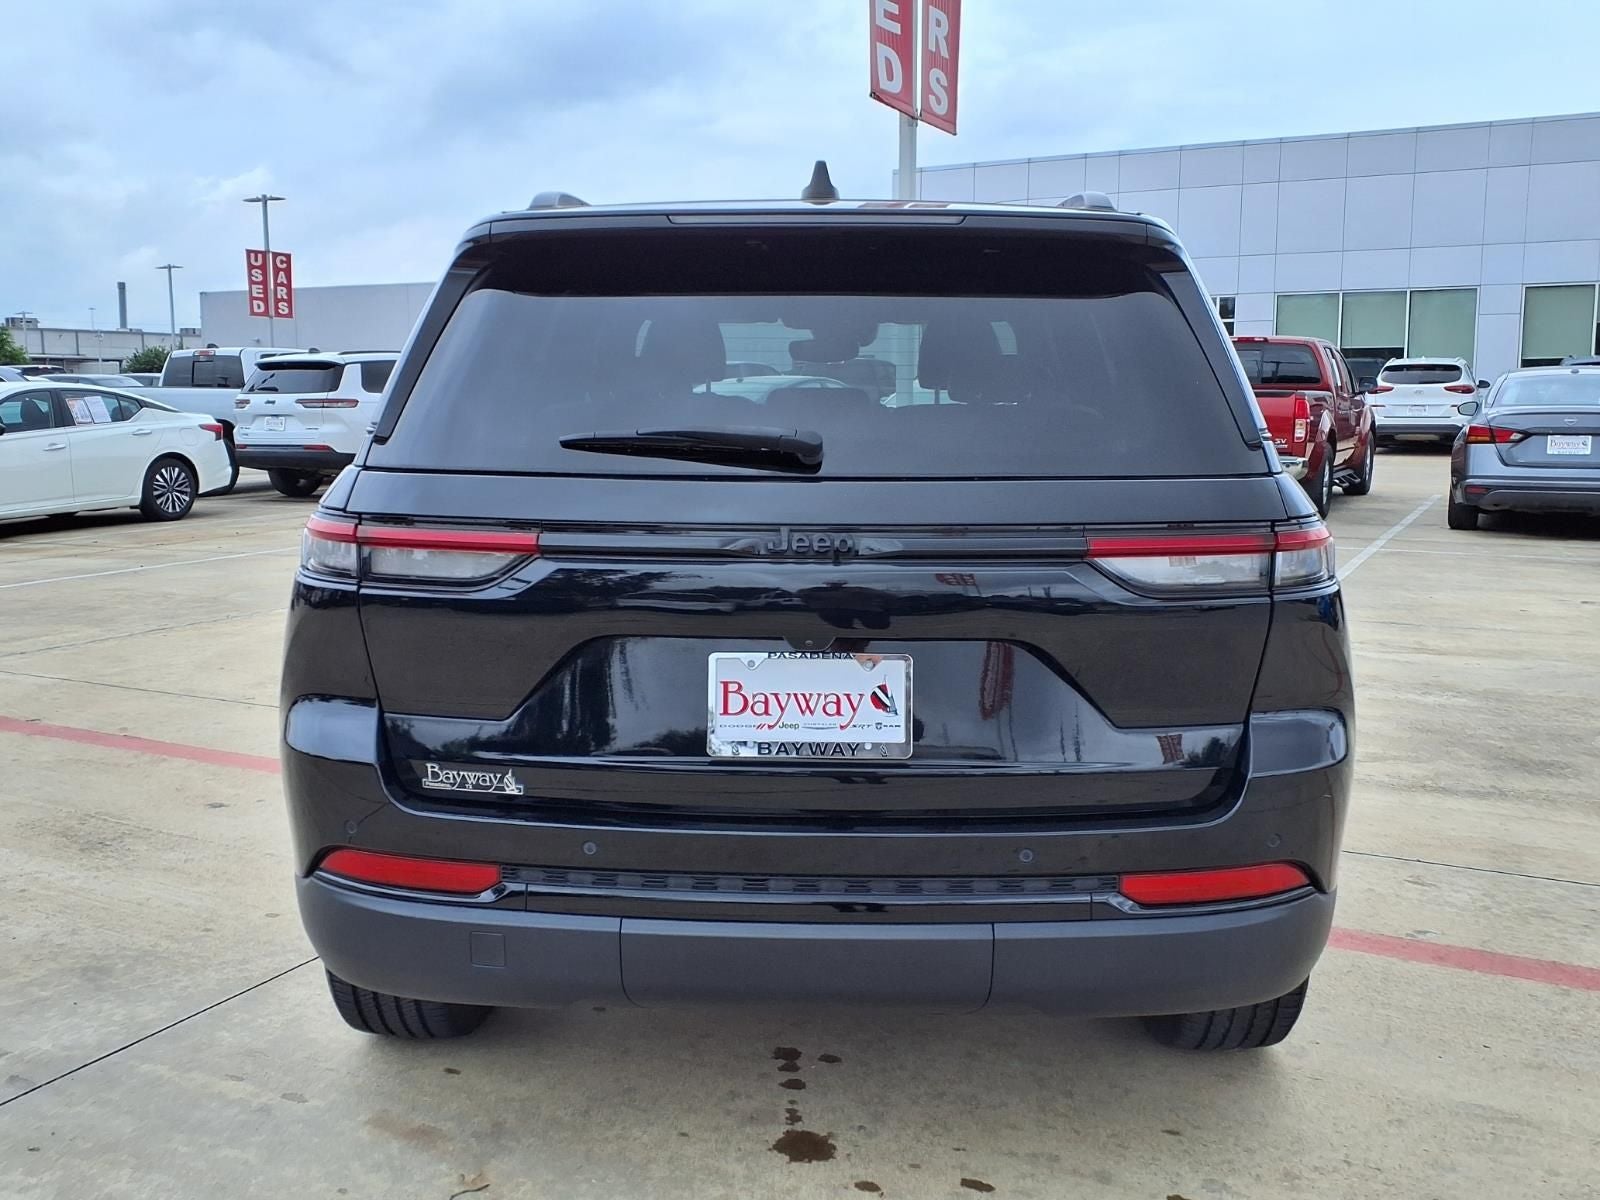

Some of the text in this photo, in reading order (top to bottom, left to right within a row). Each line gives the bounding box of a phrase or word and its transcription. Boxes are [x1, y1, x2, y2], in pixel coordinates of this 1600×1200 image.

[928, 5, 949, 115] RS
[250, 253, 265, 312] USED
[275, 255, 289, 315] CARS
[767, 527, 856, 566] Jeep
[767, 652, 855, 660] PASADENA
[719, 680, 865, 730] Bayway
[778, 720, 800, 730] Jeep
[757, 742, 860, 756] BAYWAY
[425, 763, 502, 792] Bayway
